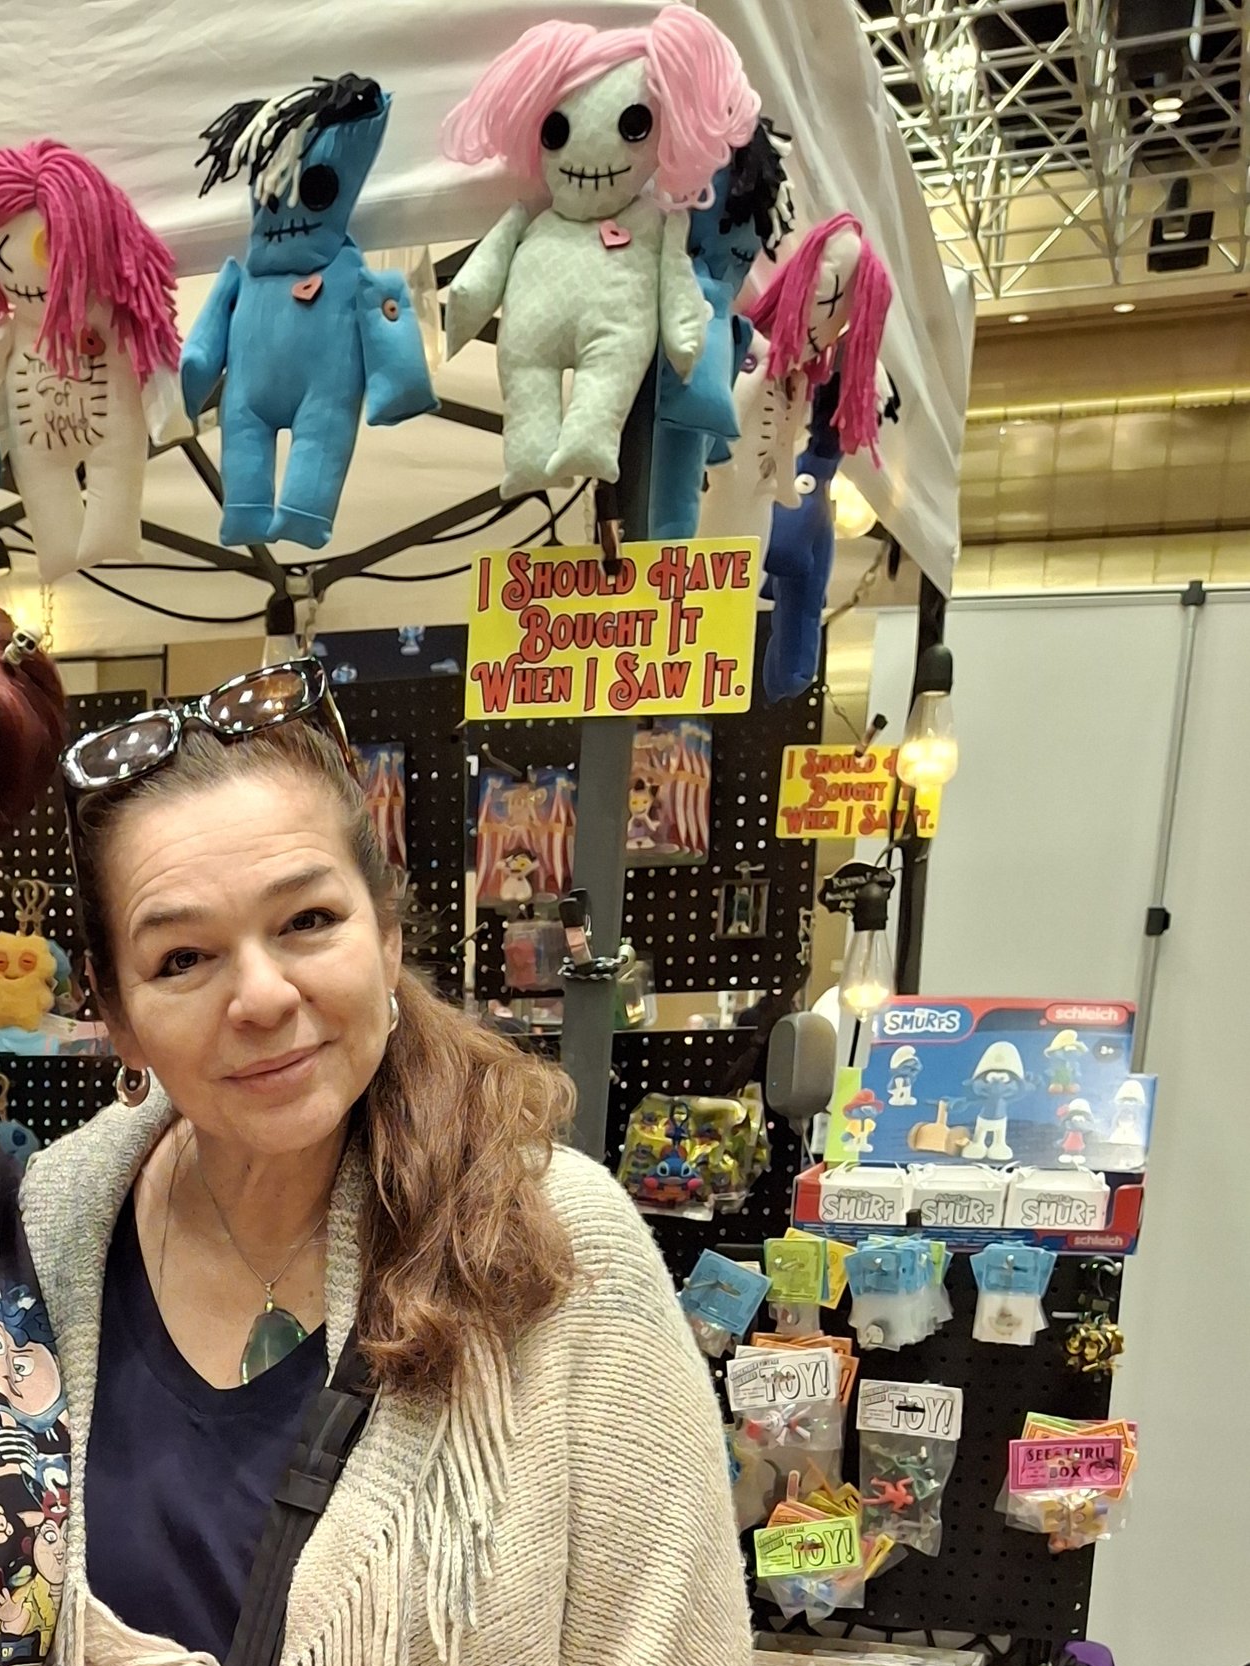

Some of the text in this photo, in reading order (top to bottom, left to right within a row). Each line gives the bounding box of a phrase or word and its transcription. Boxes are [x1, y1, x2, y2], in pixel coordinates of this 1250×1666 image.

[478, 557, 490, 612] I
[647, 546, 751, 600] HAVE
[519, 600, 703, 664] BOUGHT IT
[470, 651, 746, 713] WHEN I SAW IT.
[786, 750, 795, 780] I
[844, 806, 853, 835] I
[884, 1008, 960, 1034] SMURFS
[1054, 1007, 1119, 1021] schleich
[822, 1194, 895, 1222] SMURF
[921, 1198, 995, 1226] SMURF
[1021, 1199, 1097, 1226] SMURF
[1074, 1233, 1123, 1246] schleich
[759, 1360, 830, 1402] TOY!
[888, 1392, 954, 1435] TOY!
[785, 1528, 854, 1568] TOY!
